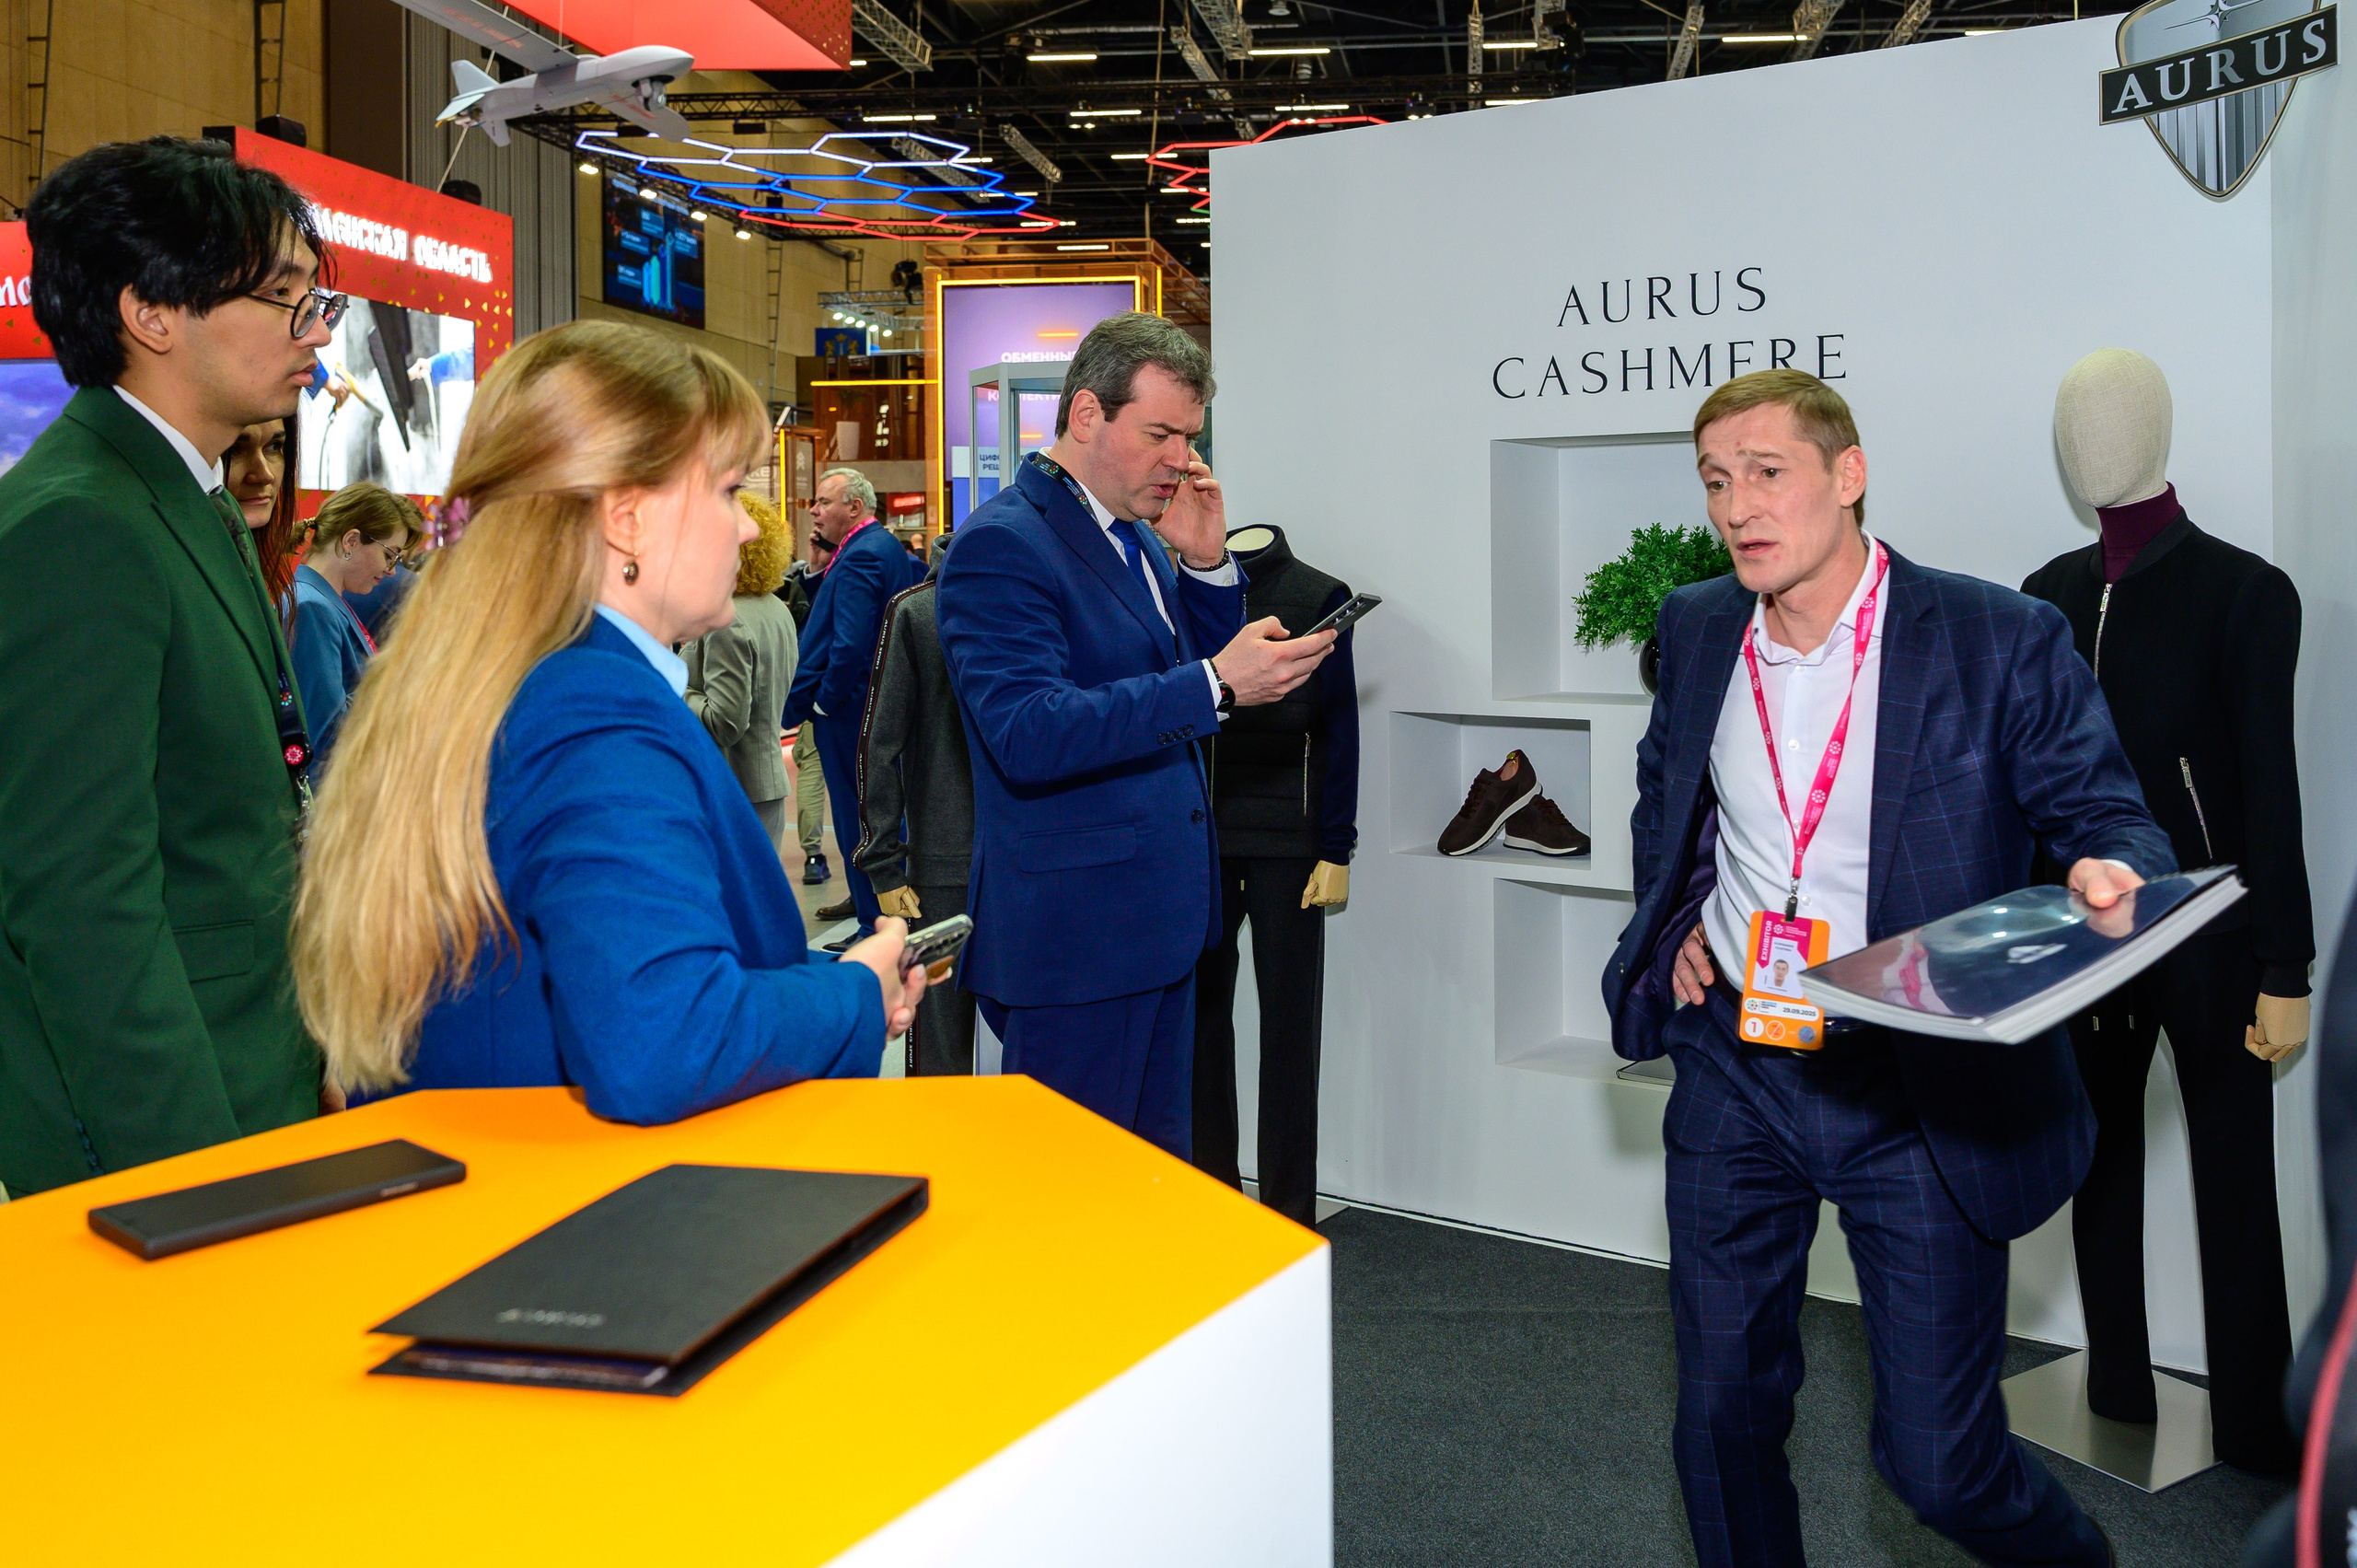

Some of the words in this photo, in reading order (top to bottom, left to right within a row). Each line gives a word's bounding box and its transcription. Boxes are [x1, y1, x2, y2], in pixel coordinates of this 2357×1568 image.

[2110, 17, 2328, 114] AURUS
[414, 235, 493, 284] ОБЛАСТЬ
[1556, 266, 1767, 328] AURUS
[1492, 333, 1847, 400] CASHMERE
[1760, 920, 1773, 961] EXHIBITOR
[1782, 1006, 1817, 1016] 29.09.2025
